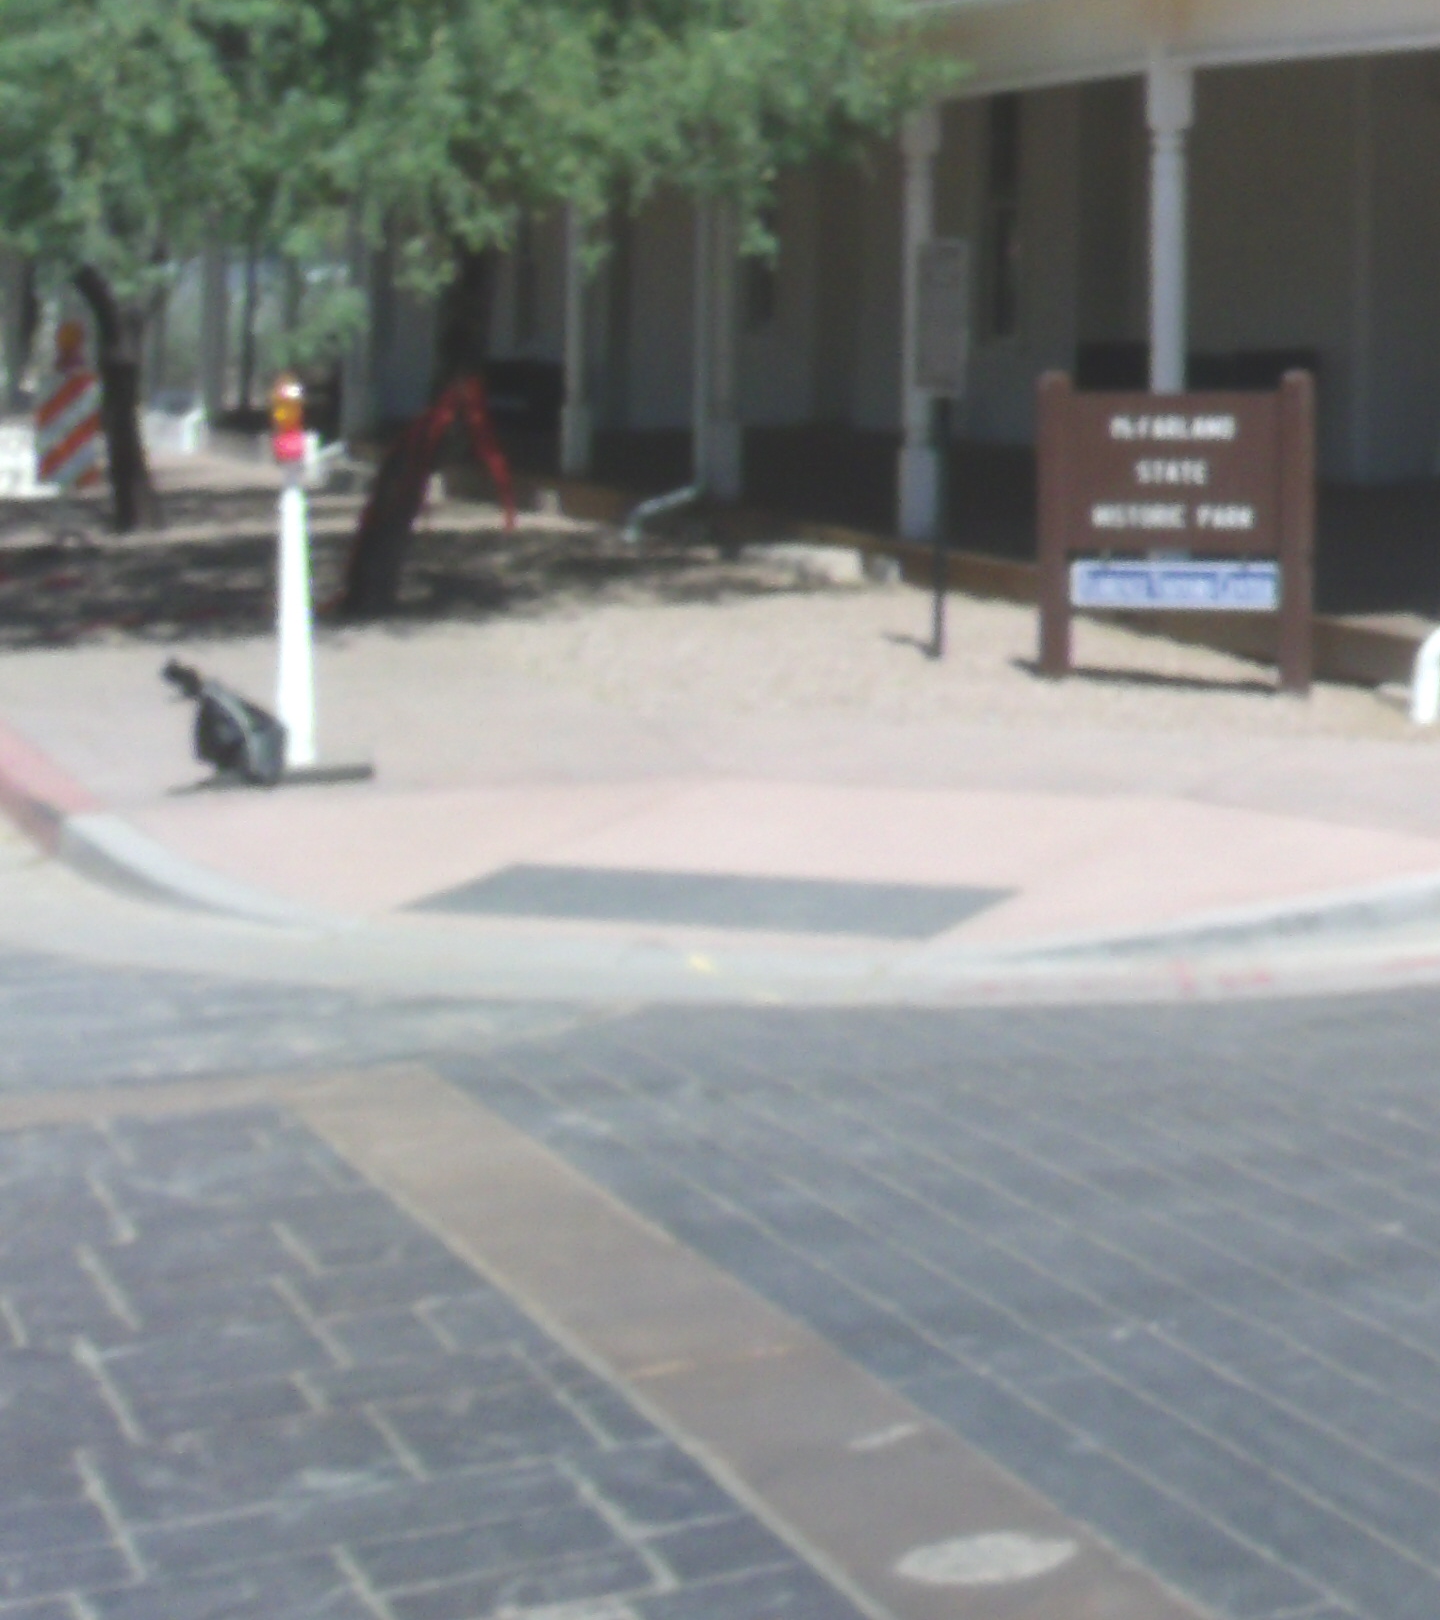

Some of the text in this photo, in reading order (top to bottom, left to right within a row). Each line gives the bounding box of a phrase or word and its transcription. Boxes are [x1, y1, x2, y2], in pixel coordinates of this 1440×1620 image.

[1135, 459, 1208, 484] STATE
[1091, 503, 1255, 530] HISTORIC PARK
